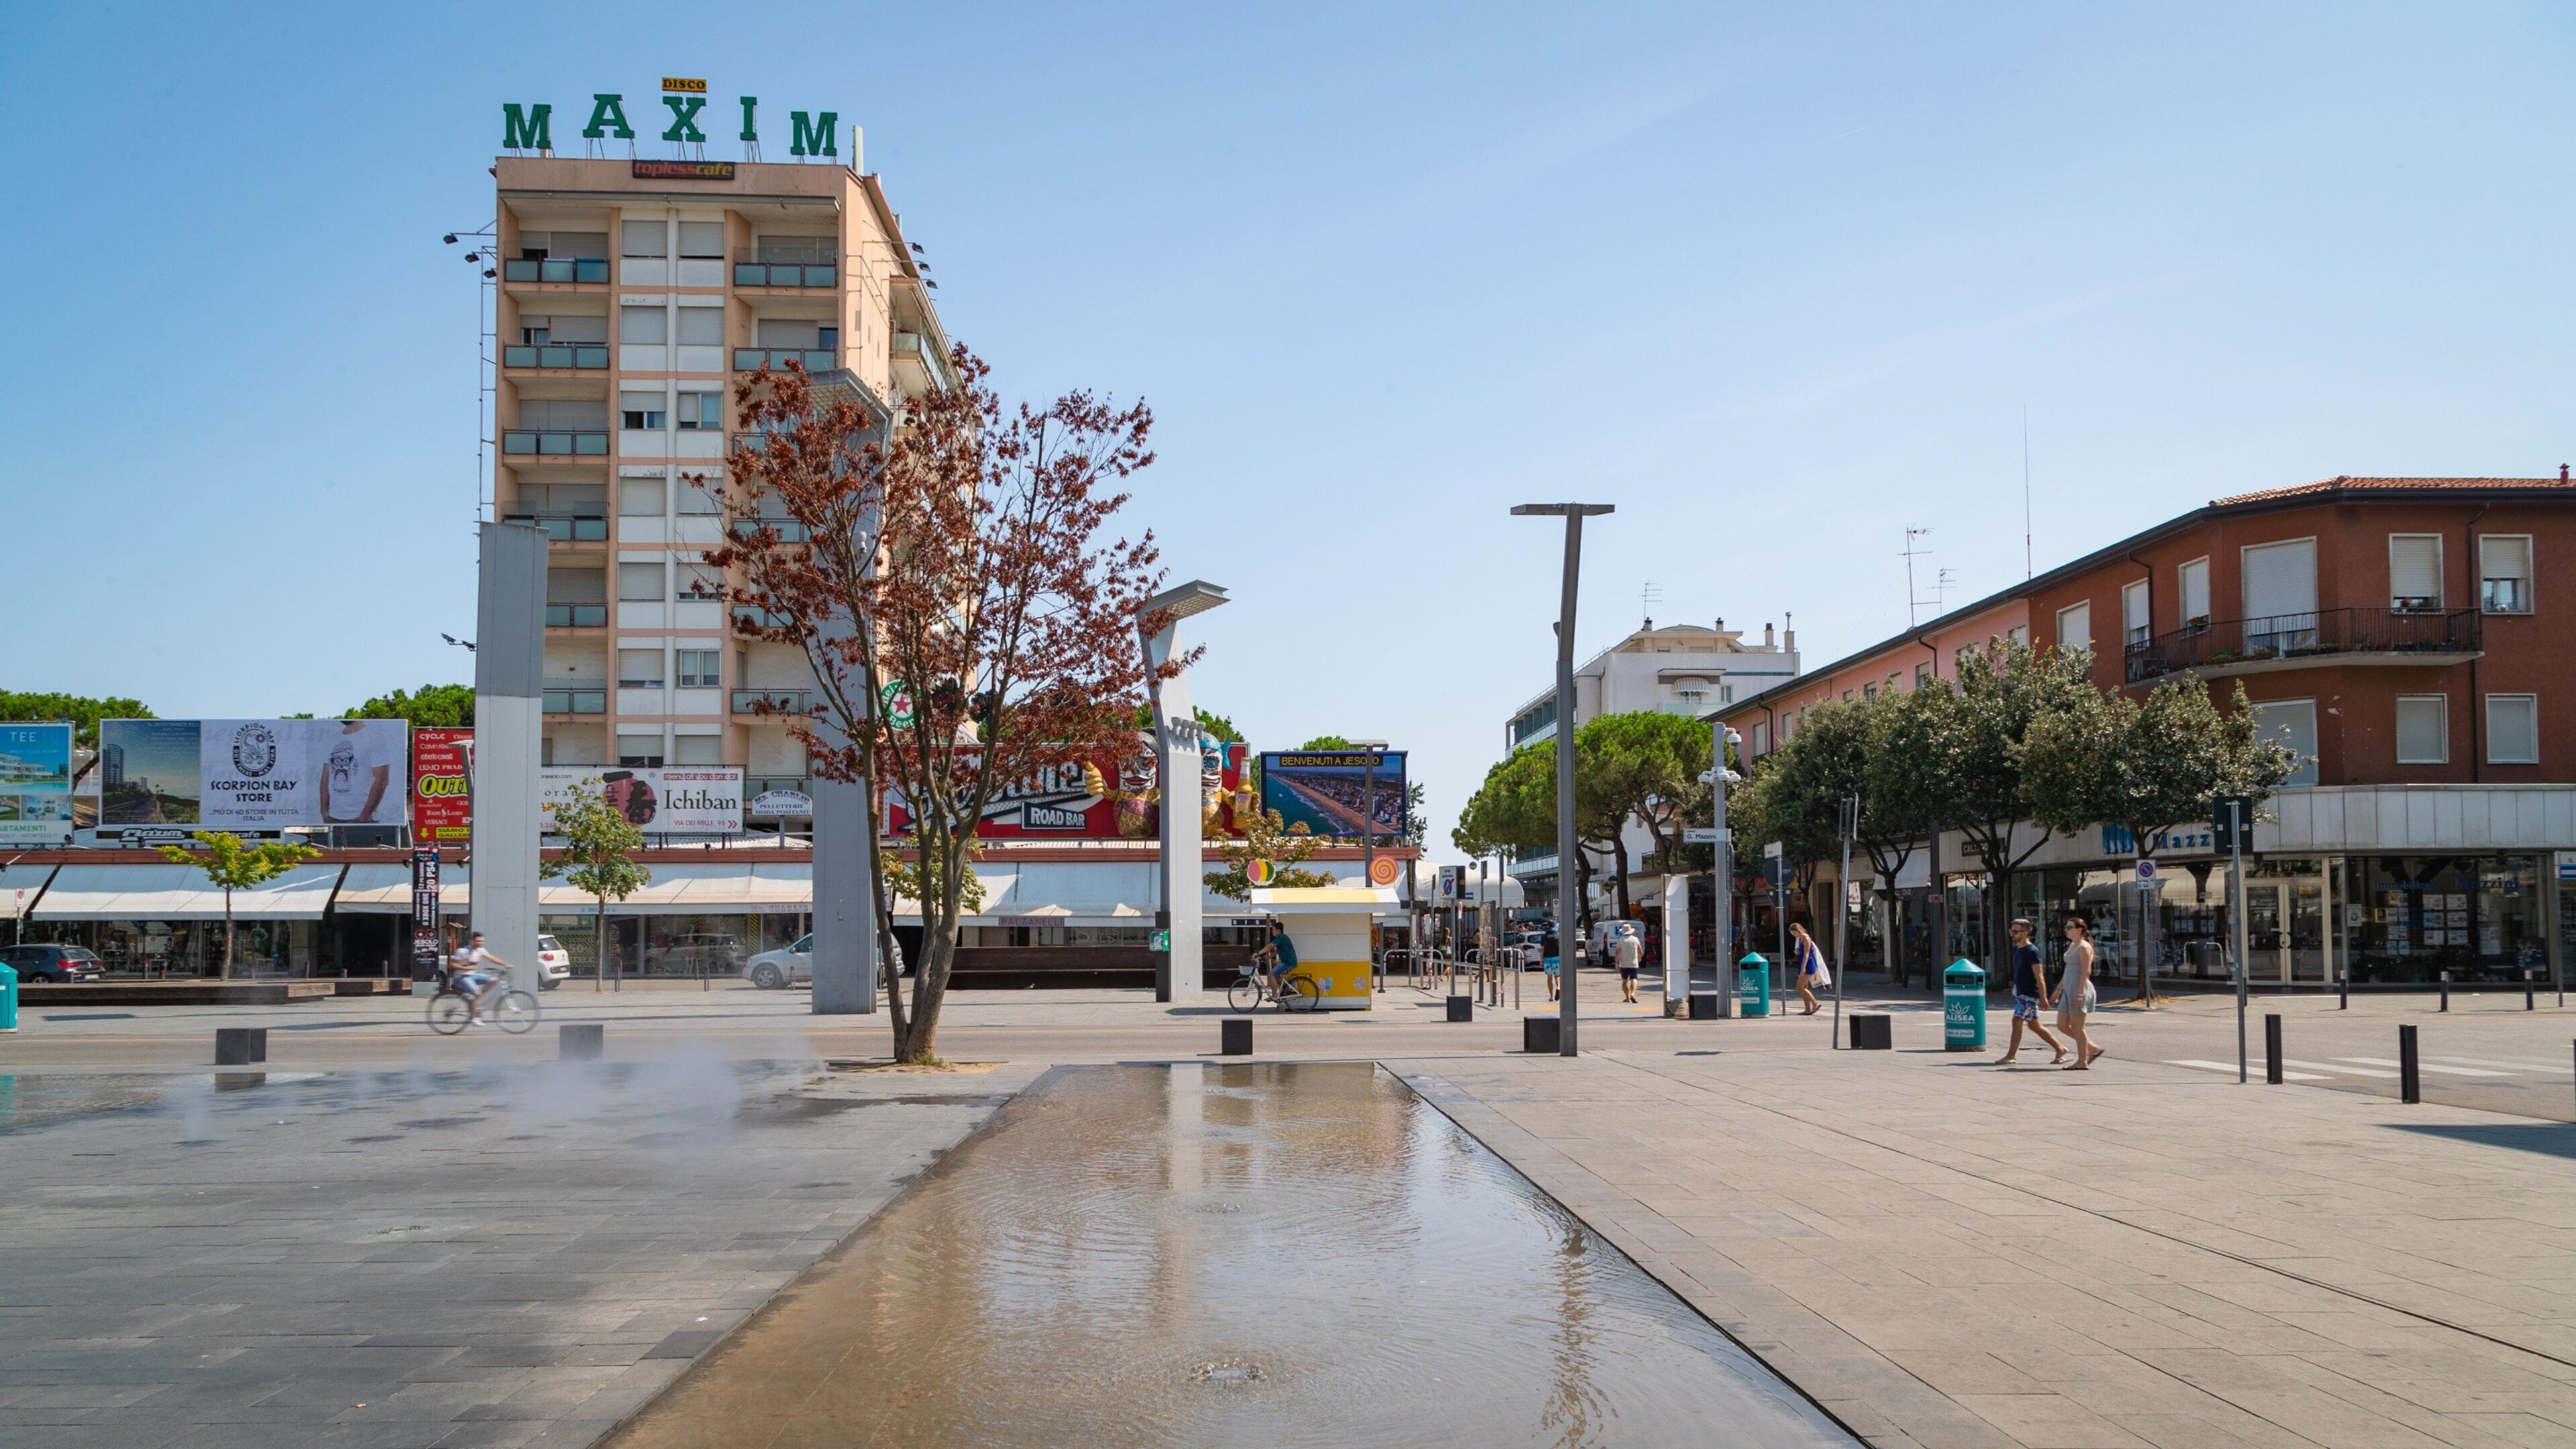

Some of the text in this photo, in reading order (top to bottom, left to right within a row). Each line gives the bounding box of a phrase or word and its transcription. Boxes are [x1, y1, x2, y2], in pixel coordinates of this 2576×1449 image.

[663, 79, 706, 91] DISCO
[502, 94, 839, 156] MAXIM
[9, 732, 37, 742] TEE
[233, 723, 276, 743] SCORPION BAY
[1281, 757, 1379, 765] BENVENUTI A JESOO
[211, 781, 297, 790] SCORPION BAY
[236, 794, 272, 802] STORE
[663, 789, 738, 810] Ichiban
[771, 790, 810, 804] CHARLIE
[1031, 807, 1085, 827] ROAD BAR
[2152, 833, 2210, 849] Mazz
[426, 861, 436, 877] PS4
[426, 879, 436, 890] 20
[2455, 877, 2520, 890] Mazzini
[1001, 918, 1063, 926] BALZANELLI
